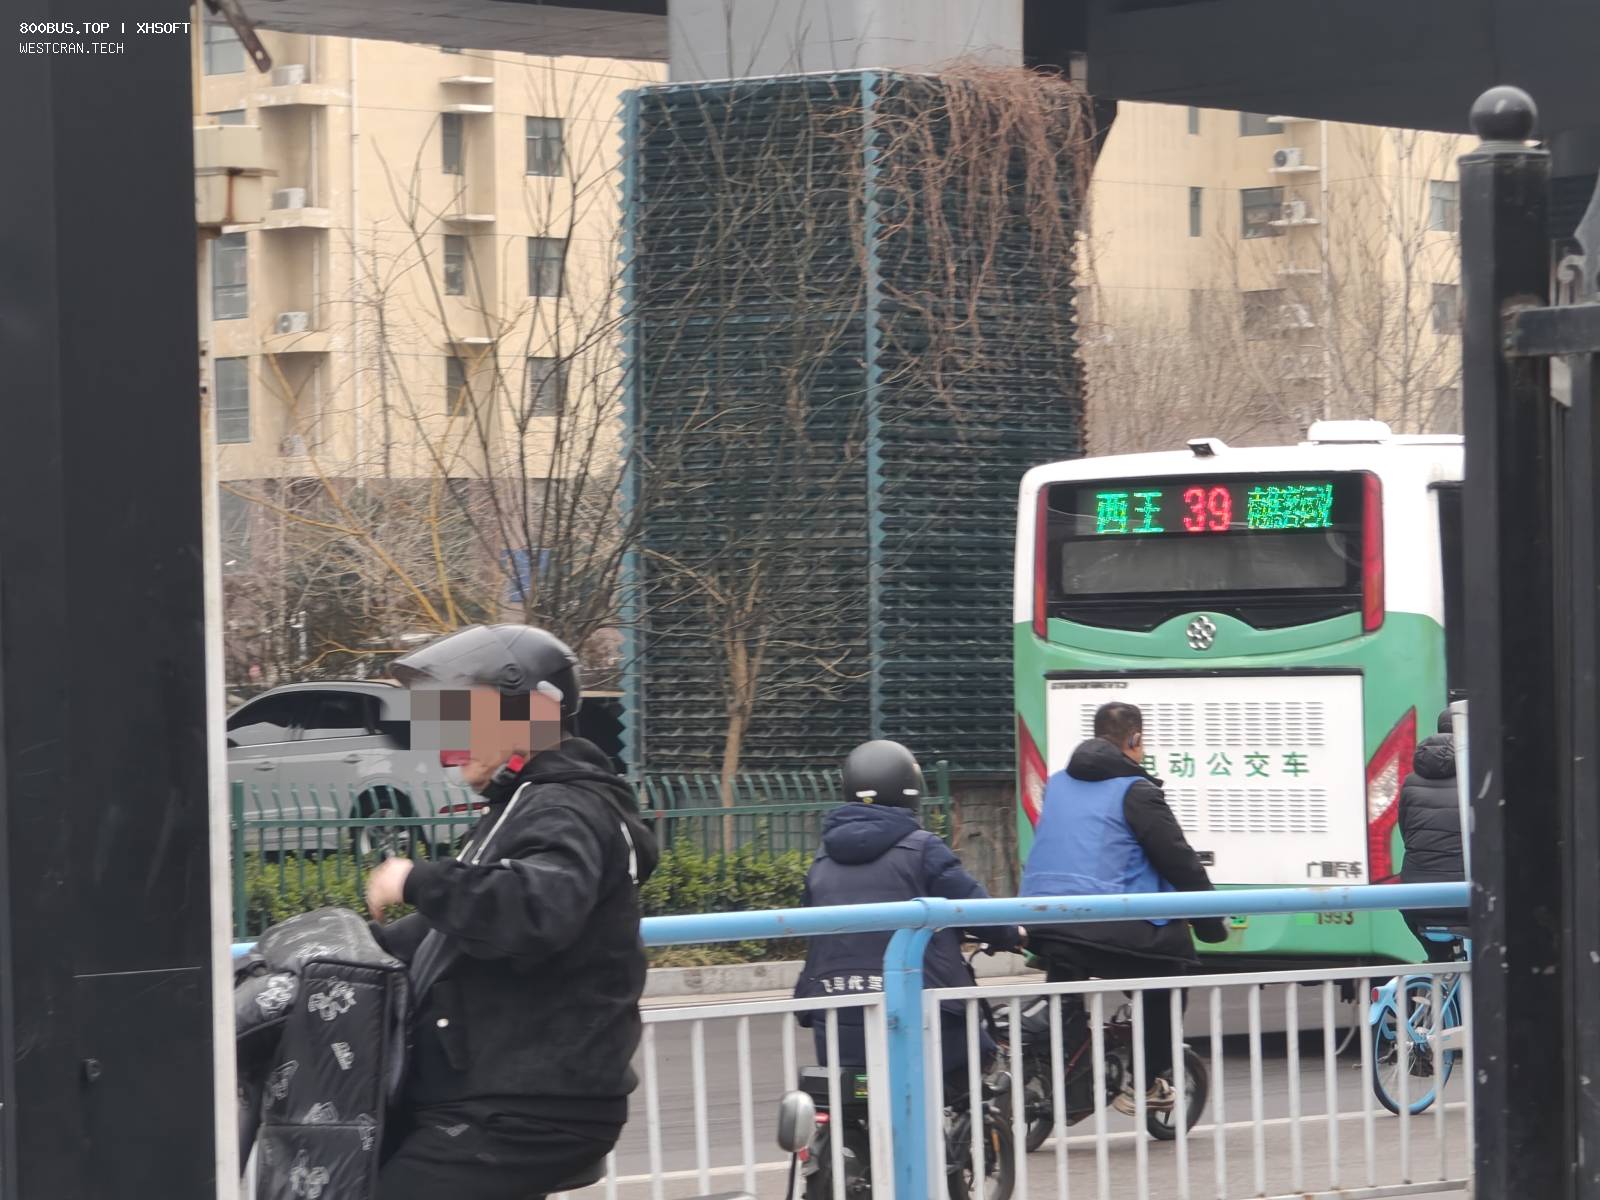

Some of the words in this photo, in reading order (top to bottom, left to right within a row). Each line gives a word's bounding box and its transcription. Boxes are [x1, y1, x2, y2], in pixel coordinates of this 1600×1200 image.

[1183, 487, 1232, 532] 39
[1140, 751, 1310, 778] 电动公交车
